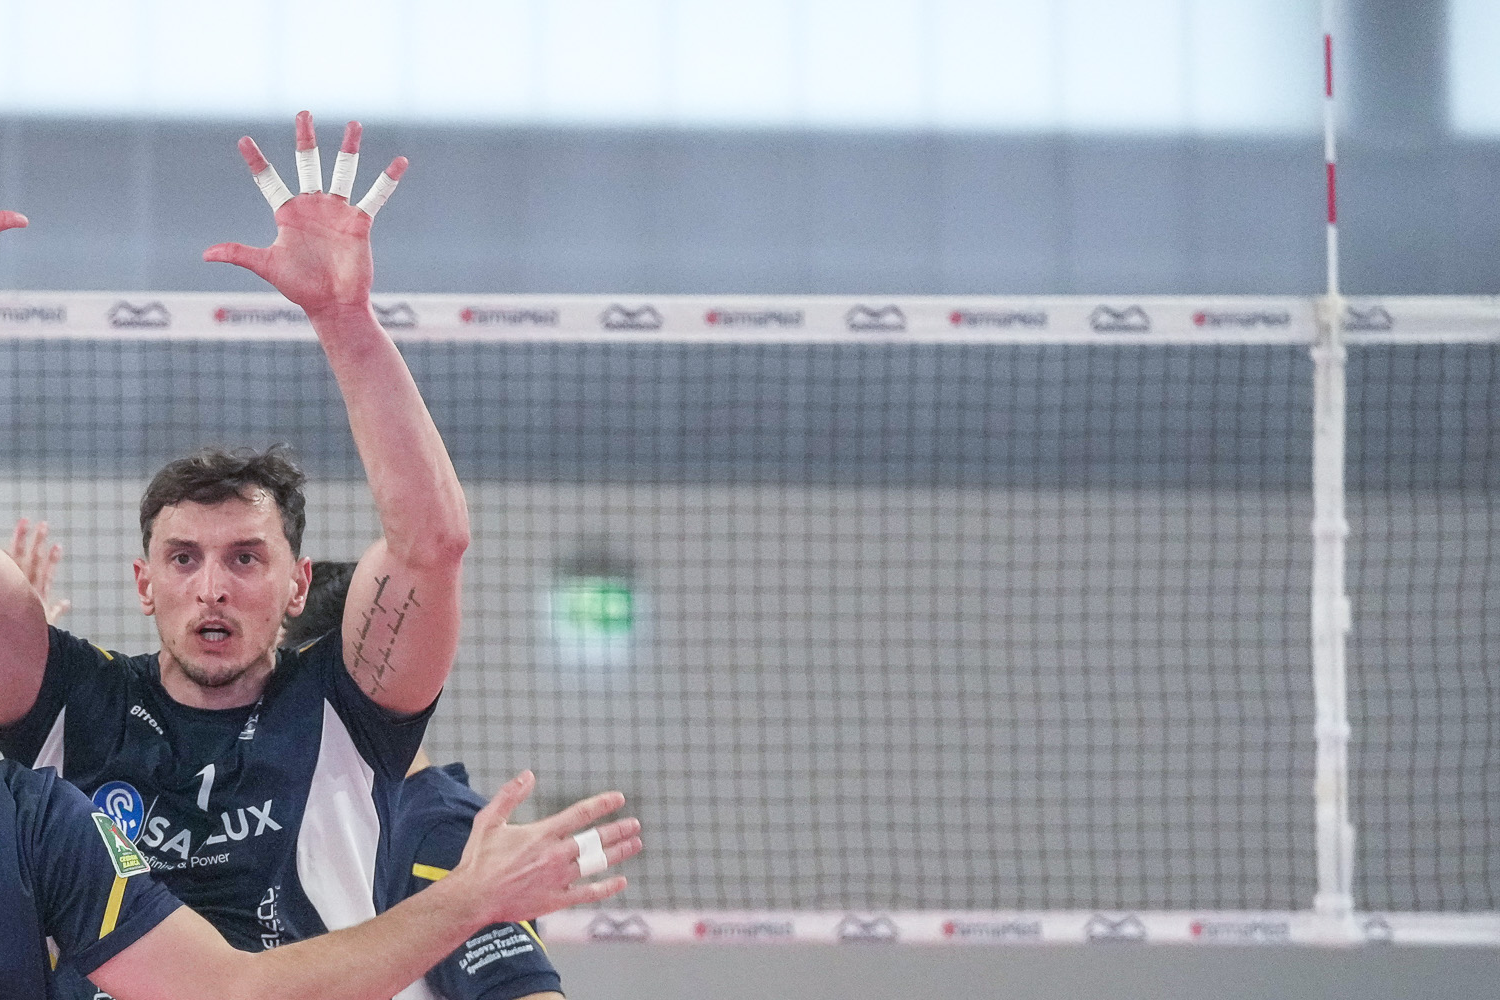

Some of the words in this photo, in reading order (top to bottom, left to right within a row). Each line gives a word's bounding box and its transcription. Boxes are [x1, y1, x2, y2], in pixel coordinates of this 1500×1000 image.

[193, 763, 216, 812] 1
[141, 799, 283, 860] SALUX
[191, 852, 230, 868] Power
